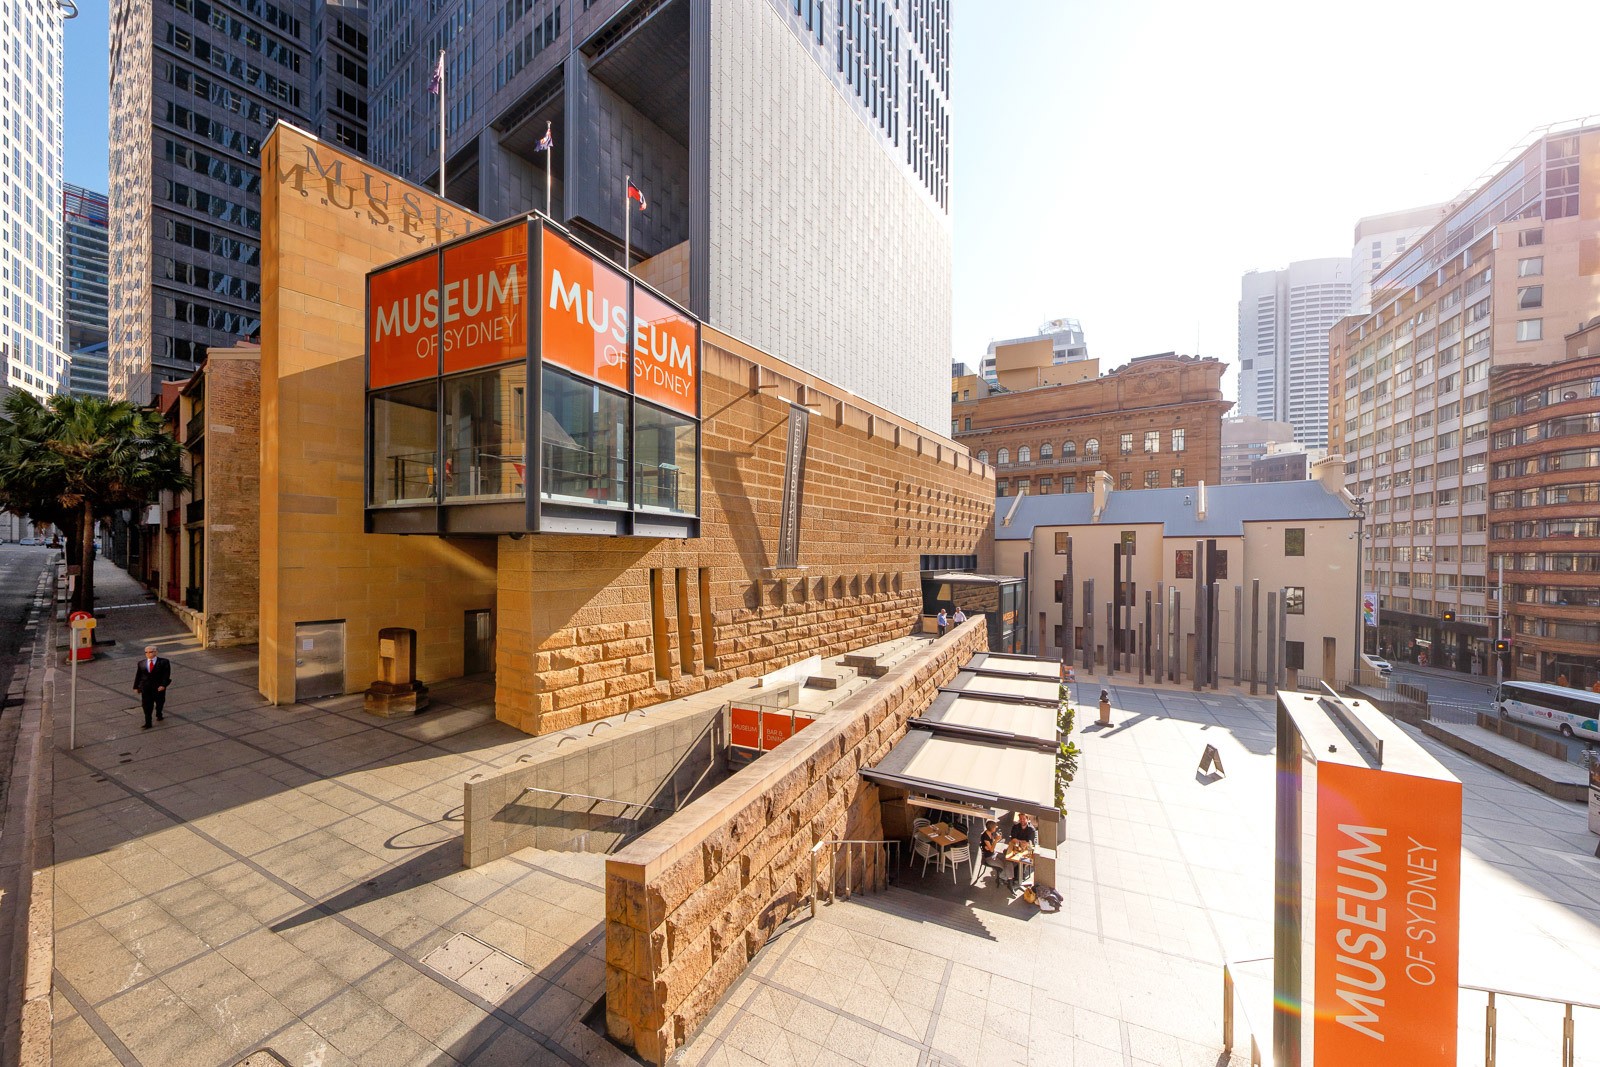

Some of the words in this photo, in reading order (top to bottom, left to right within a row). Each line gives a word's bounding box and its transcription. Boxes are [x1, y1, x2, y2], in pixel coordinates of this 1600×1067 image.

[375, 263, 520, 343] MUSEUM
[549, 268, 693, 377] MUSEUM
[416, 333, 440, 359] OF
[443, 313, 518, 352] SYDNEY
[604, 344, 629, 370] OF
[634, 357, 692, 397] SYDNEY
[792, 414, 802, 475] MUSEUM
[733, 724, 758, 732] MUSEUM
[1406, 835, 1437, 944] SYDNEY
[1335, 823, 1388, 1042] MUSEUM
[1405, 946, 1437, 986] OF
